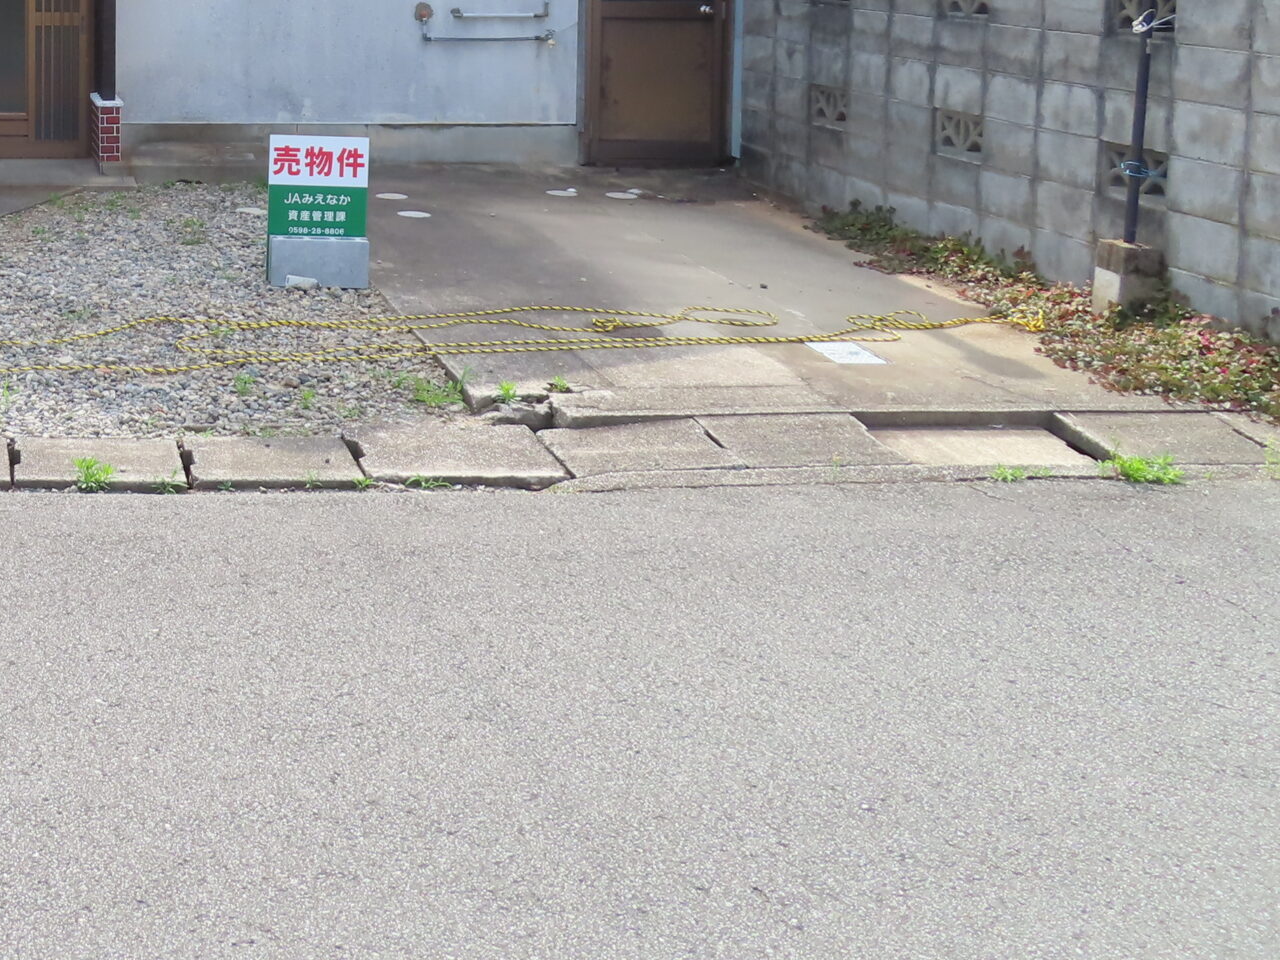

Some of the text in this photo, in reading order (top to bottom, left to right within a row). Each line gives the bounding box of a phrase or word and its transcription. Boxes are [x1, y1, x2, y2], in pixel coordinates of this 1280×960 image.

[273, 145, 365, 178] 売物件
[284, 192, 351, 205] JAみえなか
[288, 210, 346, 222] 資産管理課
